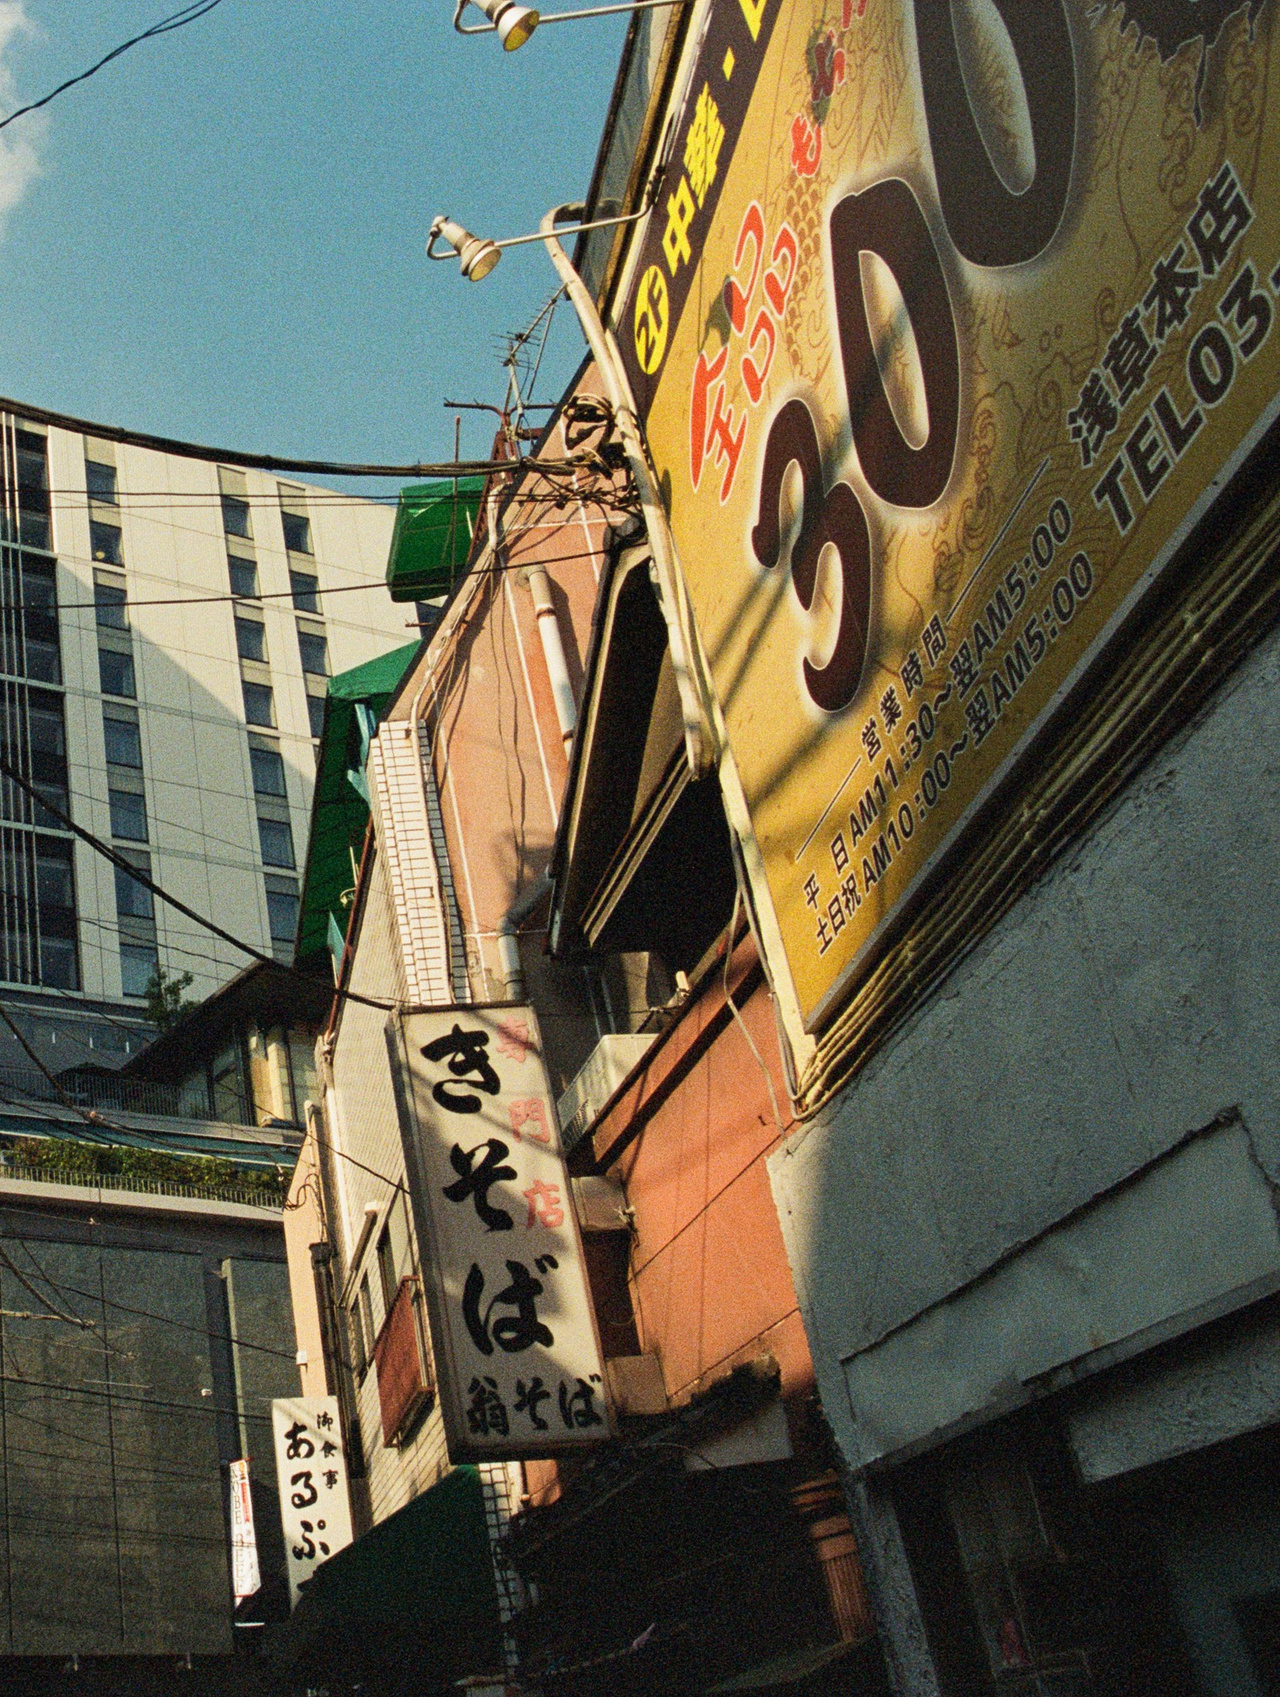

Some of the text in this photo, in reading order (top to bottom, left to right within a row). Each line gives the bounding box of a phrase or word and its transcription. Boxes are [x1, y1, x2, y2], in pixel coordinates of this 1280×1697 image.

[637, 279, 665, 362] 2F
[752, 0, 1078, 712] 300
[1068, 162, 1255, 467] 浅草本店
[863, 616, 947, 762] 営業時間
[420, 1023, 559, 1356] きそば
[317, 1411, 338, 1489] 御食事
[466, 1374, 603, 1436] 翁そば
[285, 1422, 330, 1590] あるぷ
